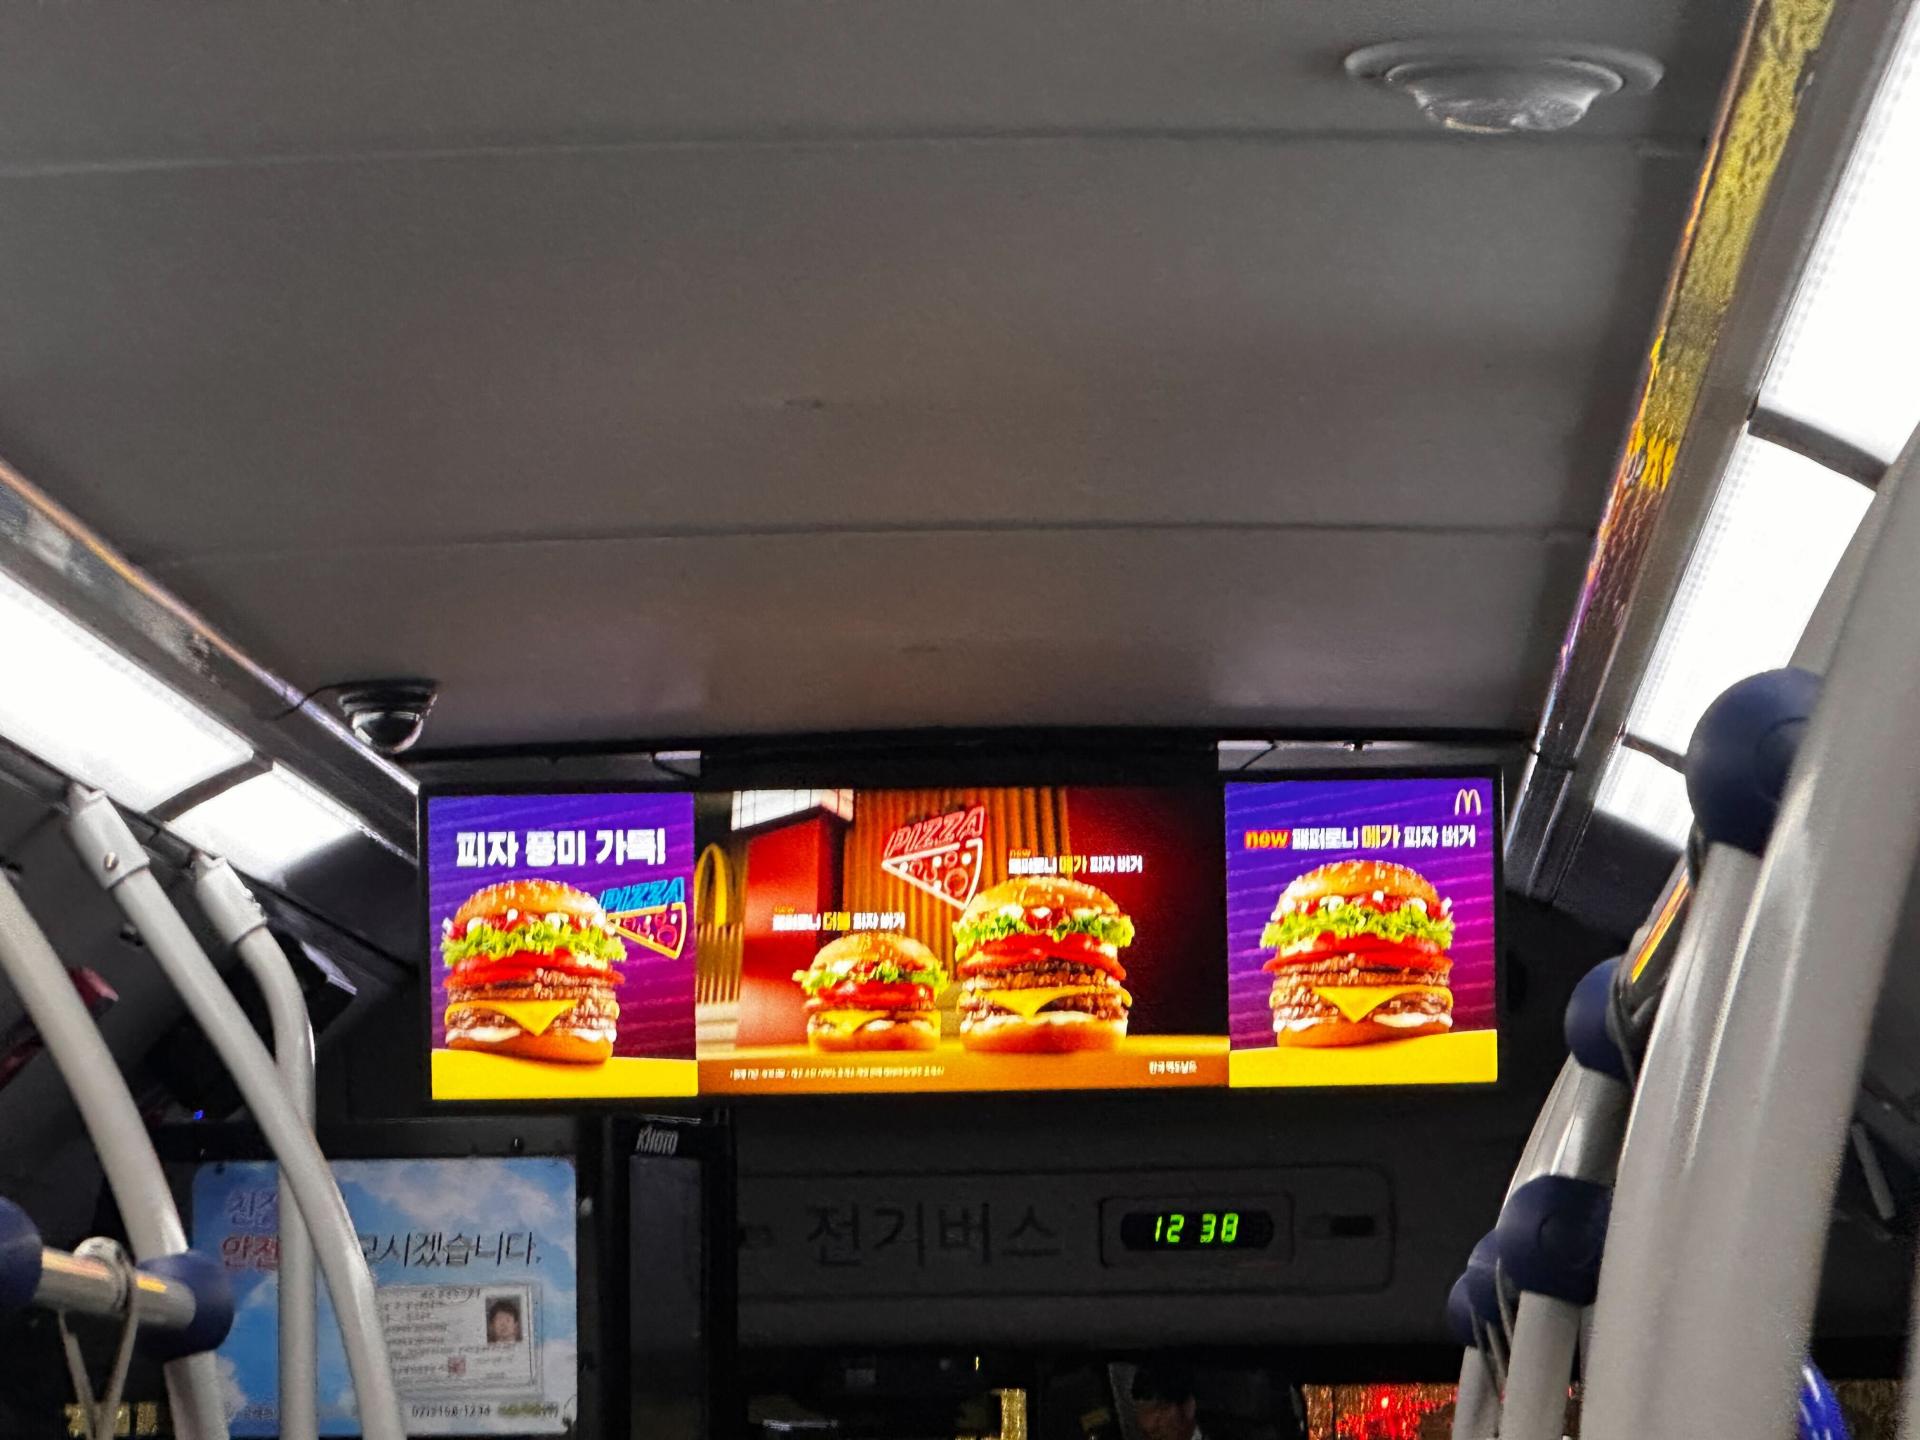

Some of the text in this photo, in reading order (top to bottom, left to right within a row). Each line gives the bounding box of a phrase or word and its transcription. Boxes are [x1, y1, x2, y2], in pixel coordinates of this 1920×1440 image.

[456, 828, 665, 868] 피자 풍미 가득!
[884, 806, 986, 858] PIZZA
[1244, 829, 1291, 849] new
[1361, 825, 1400, 848] 메가
[1404, 825, 1439, 848] 피자
[1442, 824, 1476, 848] 버거
[1089, 855, 1115, 874] 피자
[1116, 854, 1143, 874] 버거
[600, 877, 686, 913] PIZZA
[806, 1202, 1062, 1267] 전기버스
